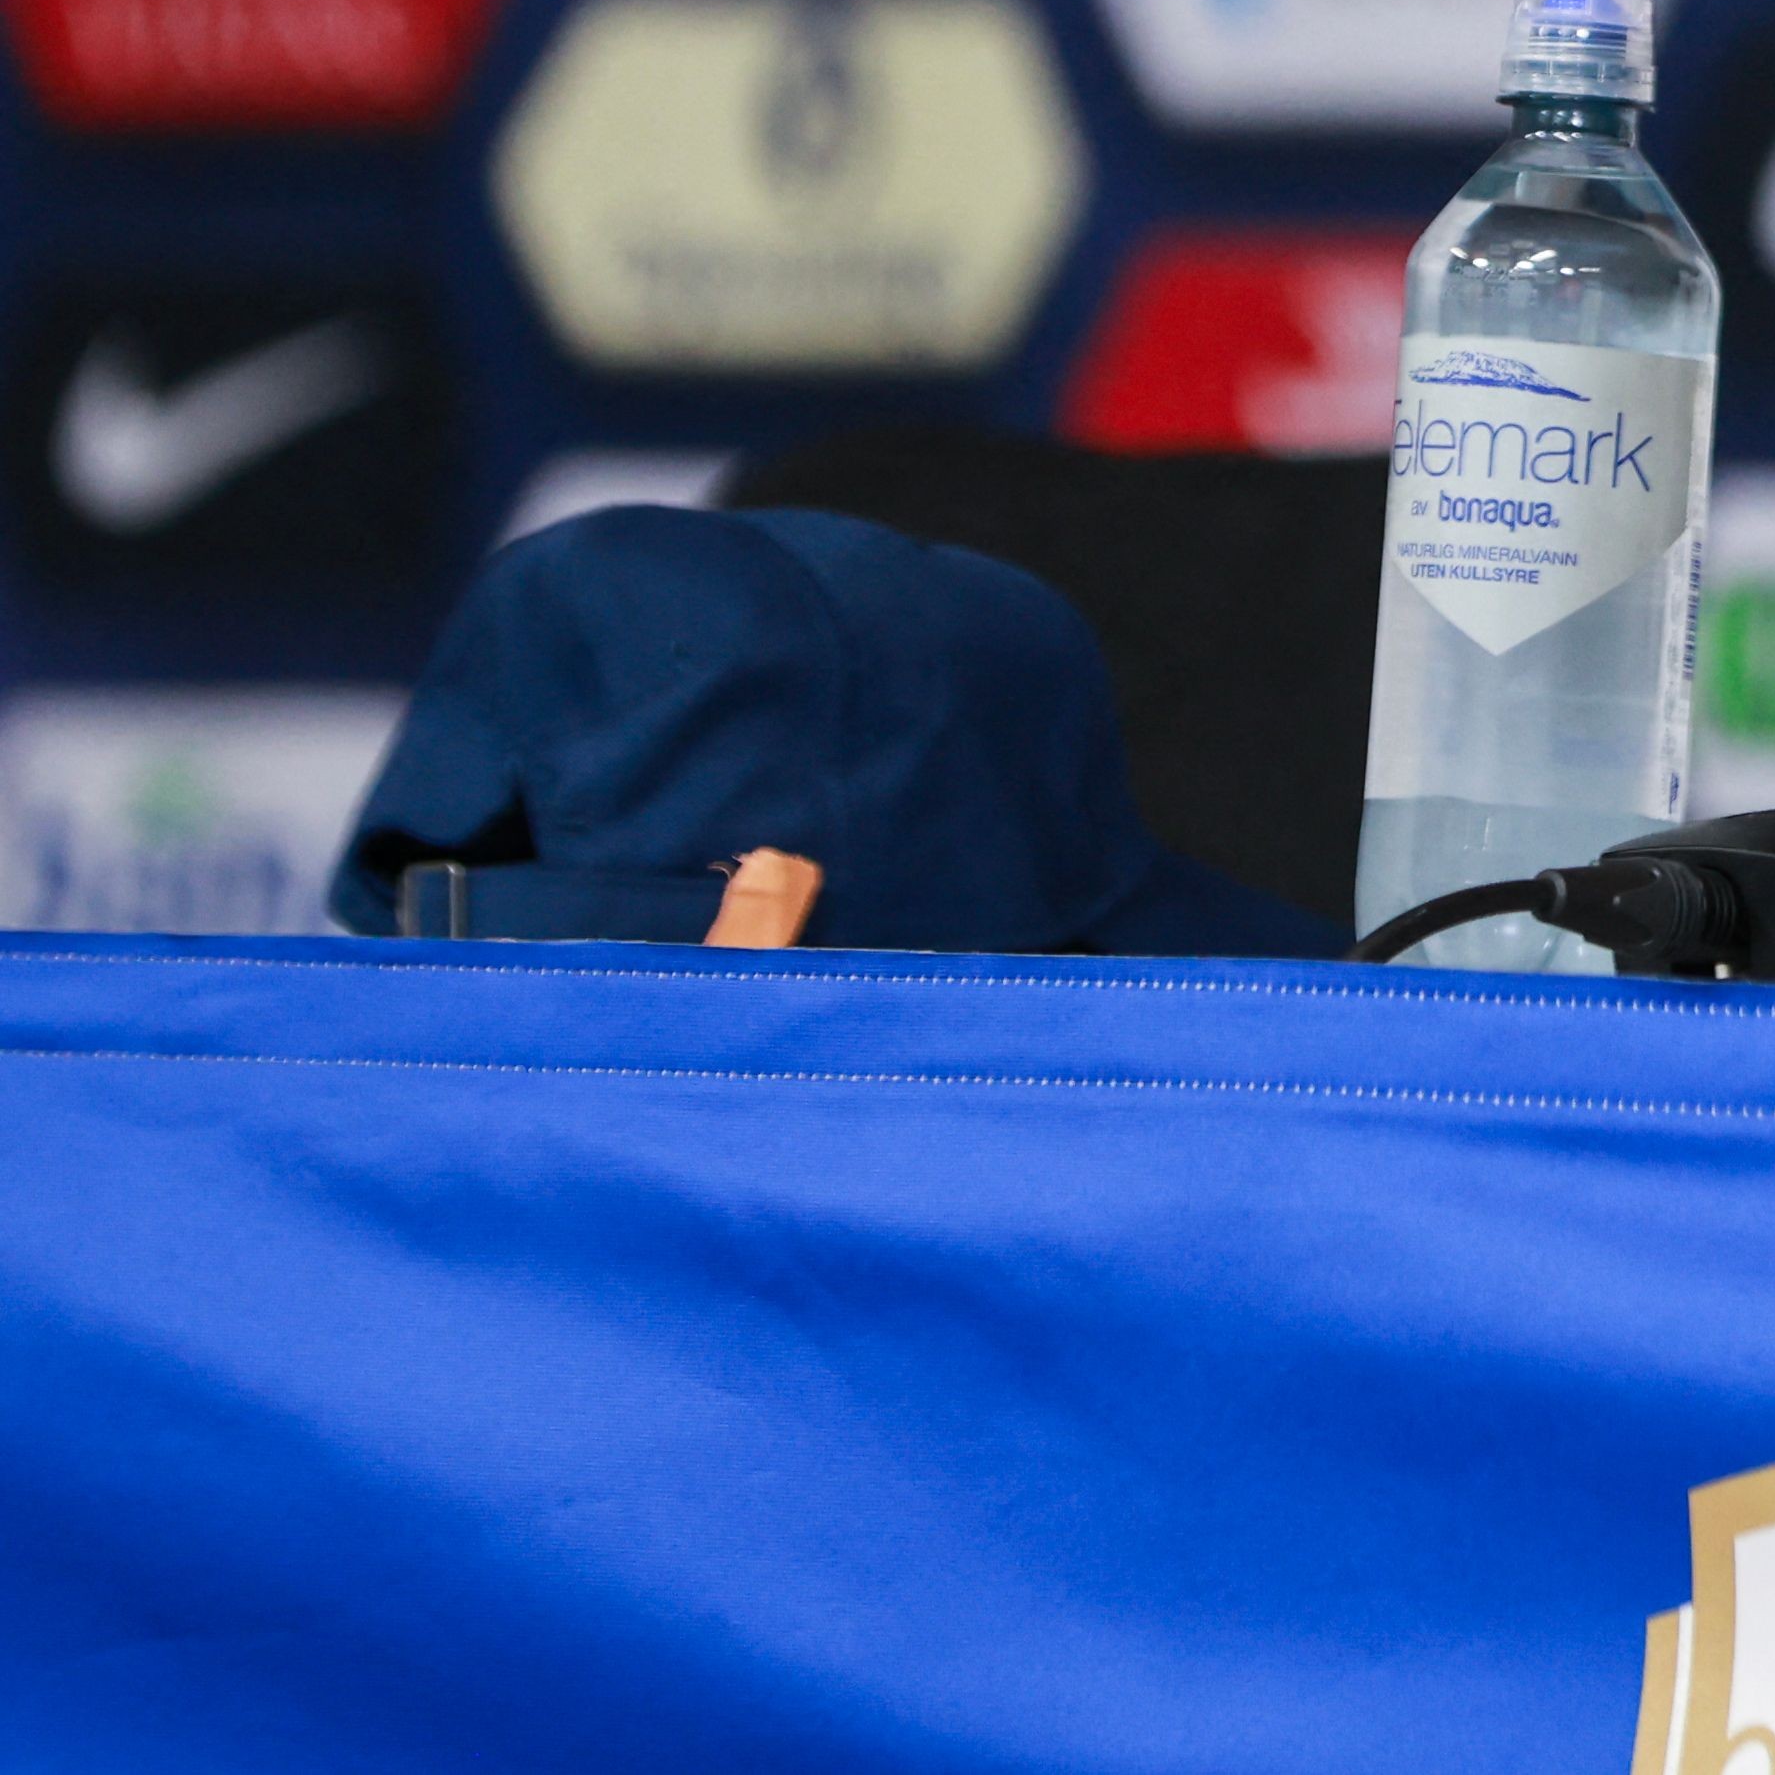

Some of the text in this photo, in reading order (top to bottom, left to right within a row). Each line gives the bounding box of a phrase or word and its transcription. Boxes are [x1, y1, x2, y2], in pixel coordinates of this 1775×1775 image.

[1411, 499, 1429, 516] av
[1458, 544, 1578, 568] MINERALVANN
[1410, 563, 1541, 585] UTEN KULLSYRE
